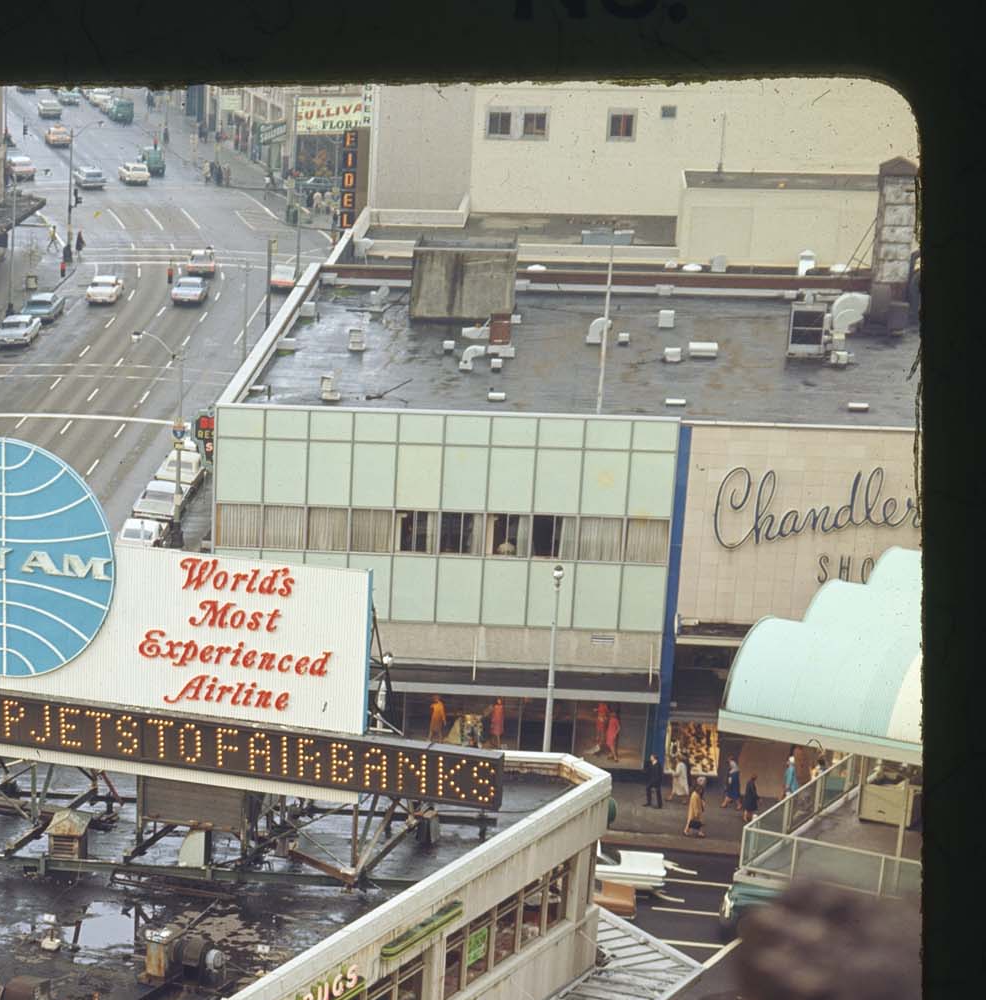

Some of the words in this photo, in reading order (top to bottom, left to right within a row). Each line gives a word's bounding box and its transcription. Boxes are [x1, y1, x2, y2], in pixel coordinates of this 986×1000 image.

[21, 550, 113, 581] AM
[179, 557, 295, 597] World's
[188, 600, 282, 633] Most
[138, 629, 333, 677] Experienced
[163, 674, 290, 711] Airline
[30, 704, 139, 754] JETS
[147, 718, 203, 763] TO
[216, 728, 497, 802] FAIRBANKS
